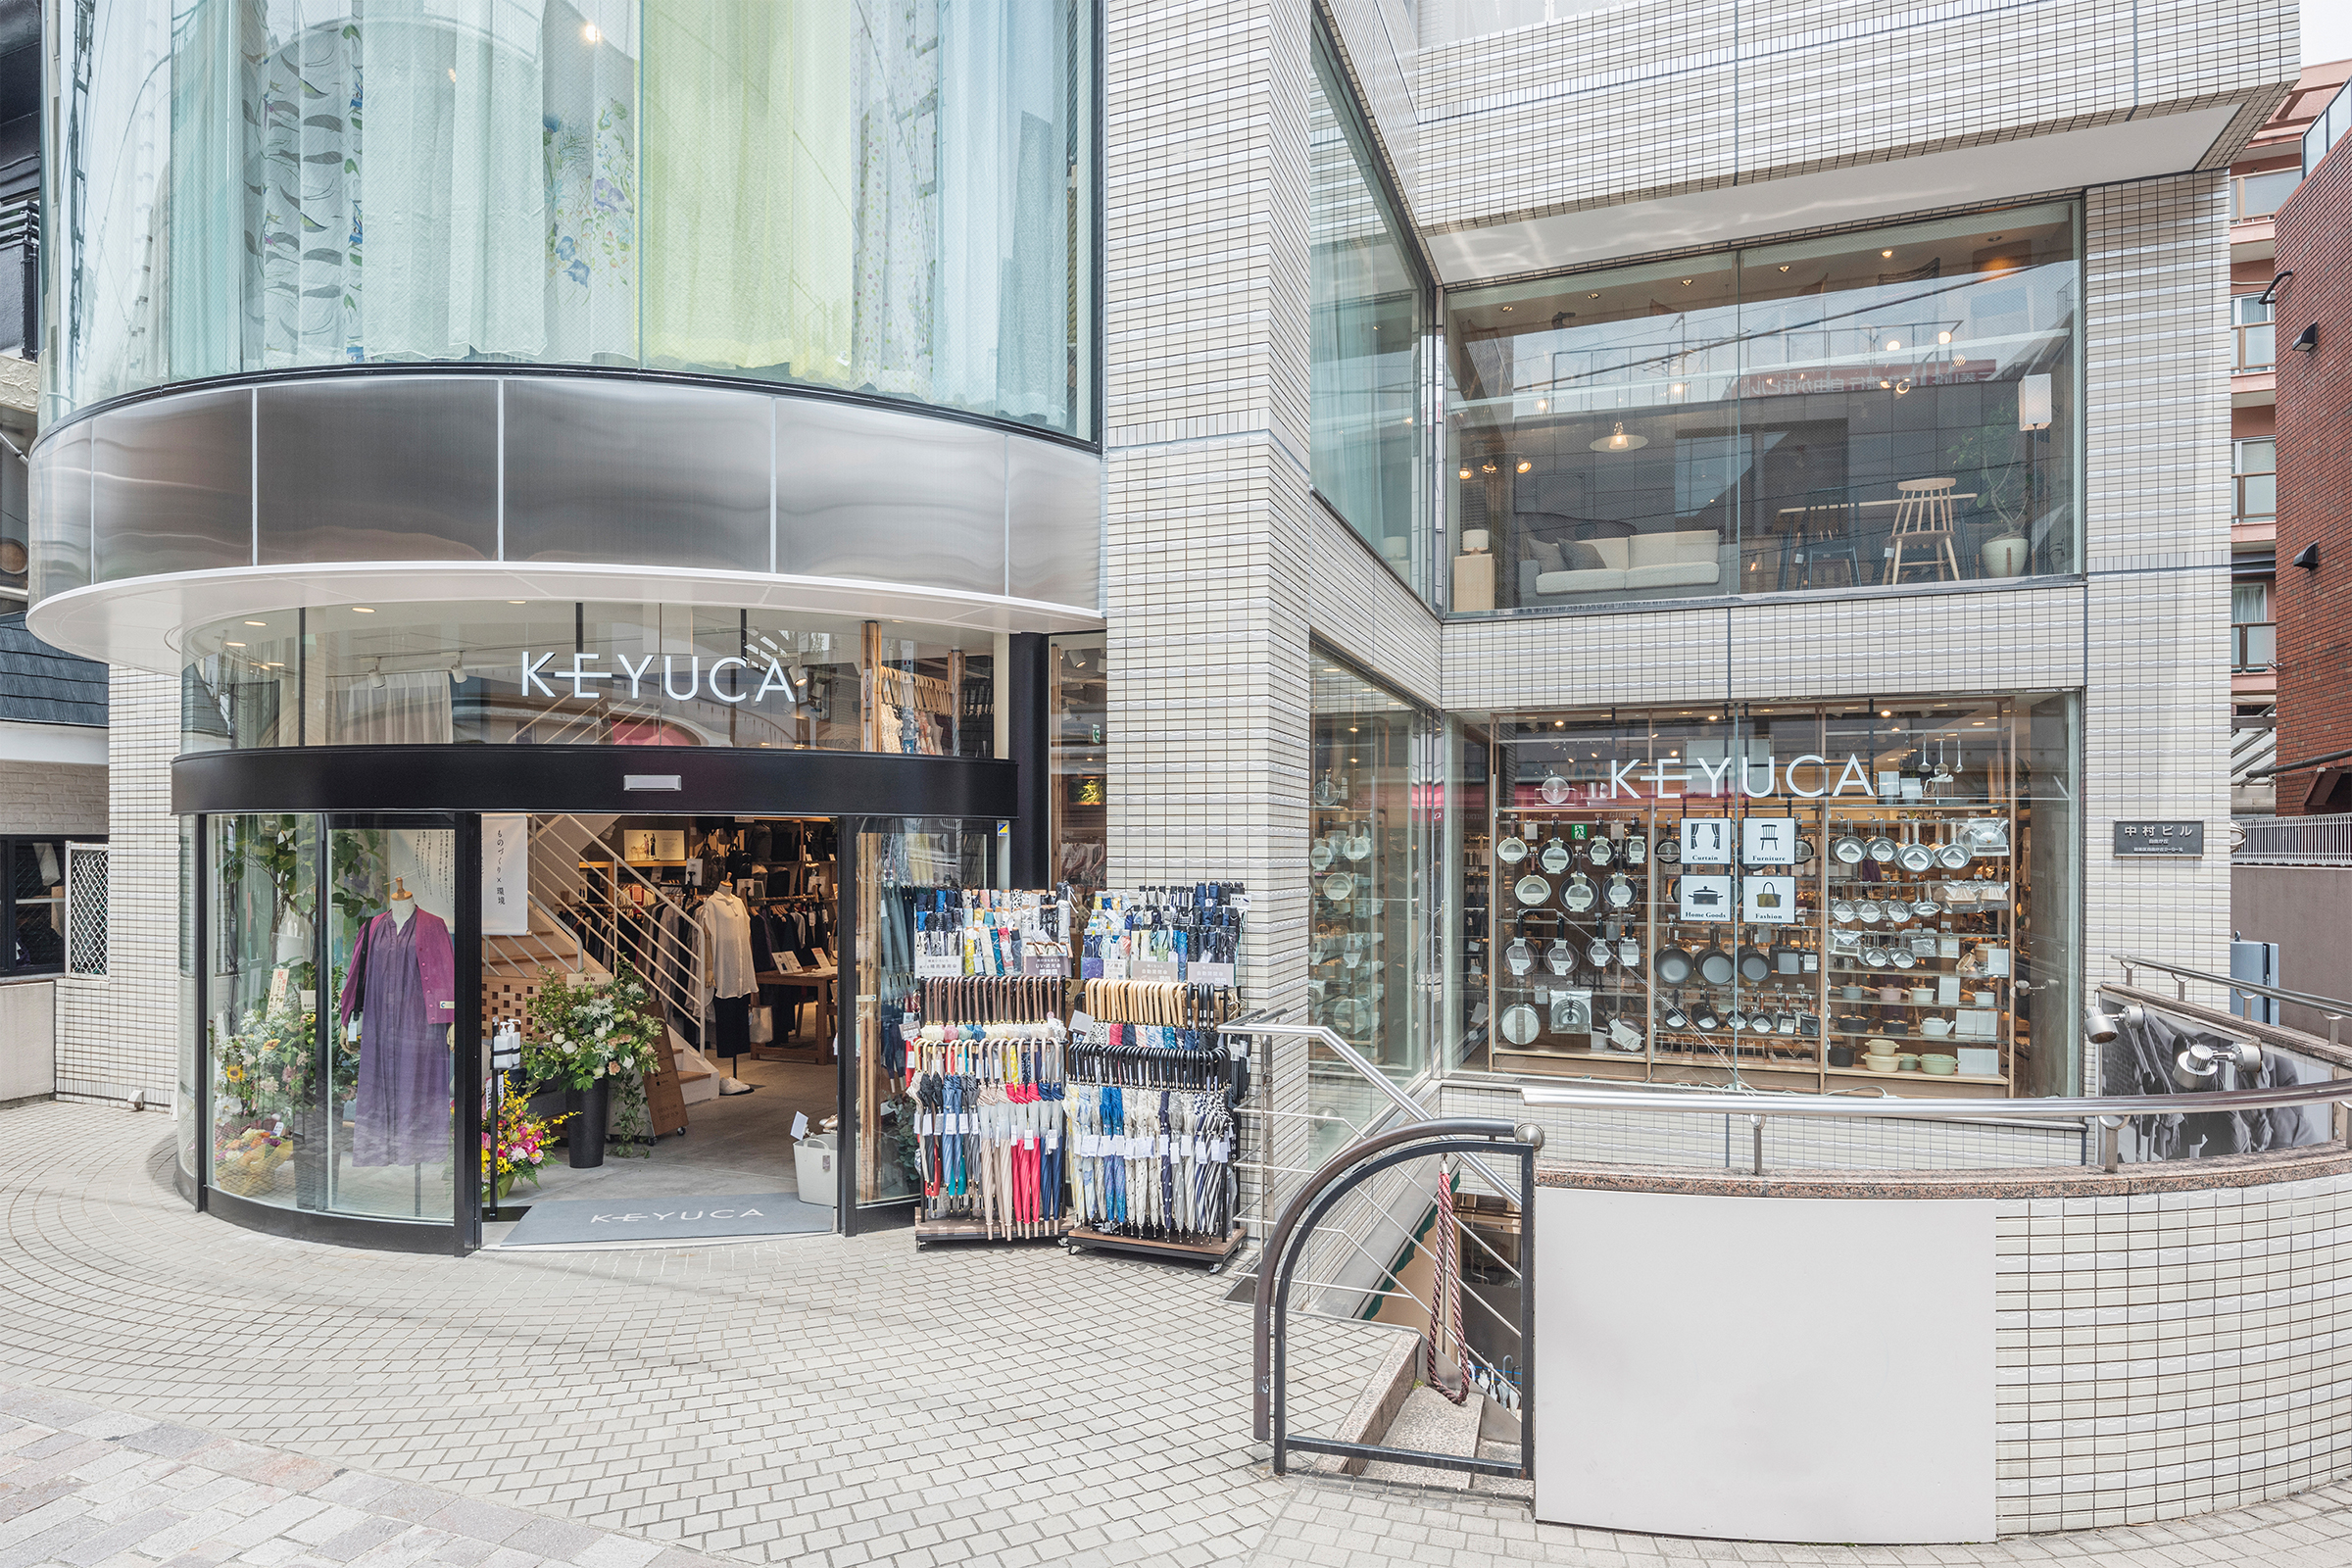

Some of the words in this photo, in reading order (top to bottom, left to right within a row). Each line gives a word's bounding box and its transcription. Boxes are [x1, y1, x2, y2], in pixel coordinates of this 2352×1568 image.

[521, 651, 796, 703] KEYUCA
[1610, 753, 1876, 800] KEYUCA
[2124, 825, 2193, 837] 中村ビル
[590, 1207, 765, 1224] KEYUCA
